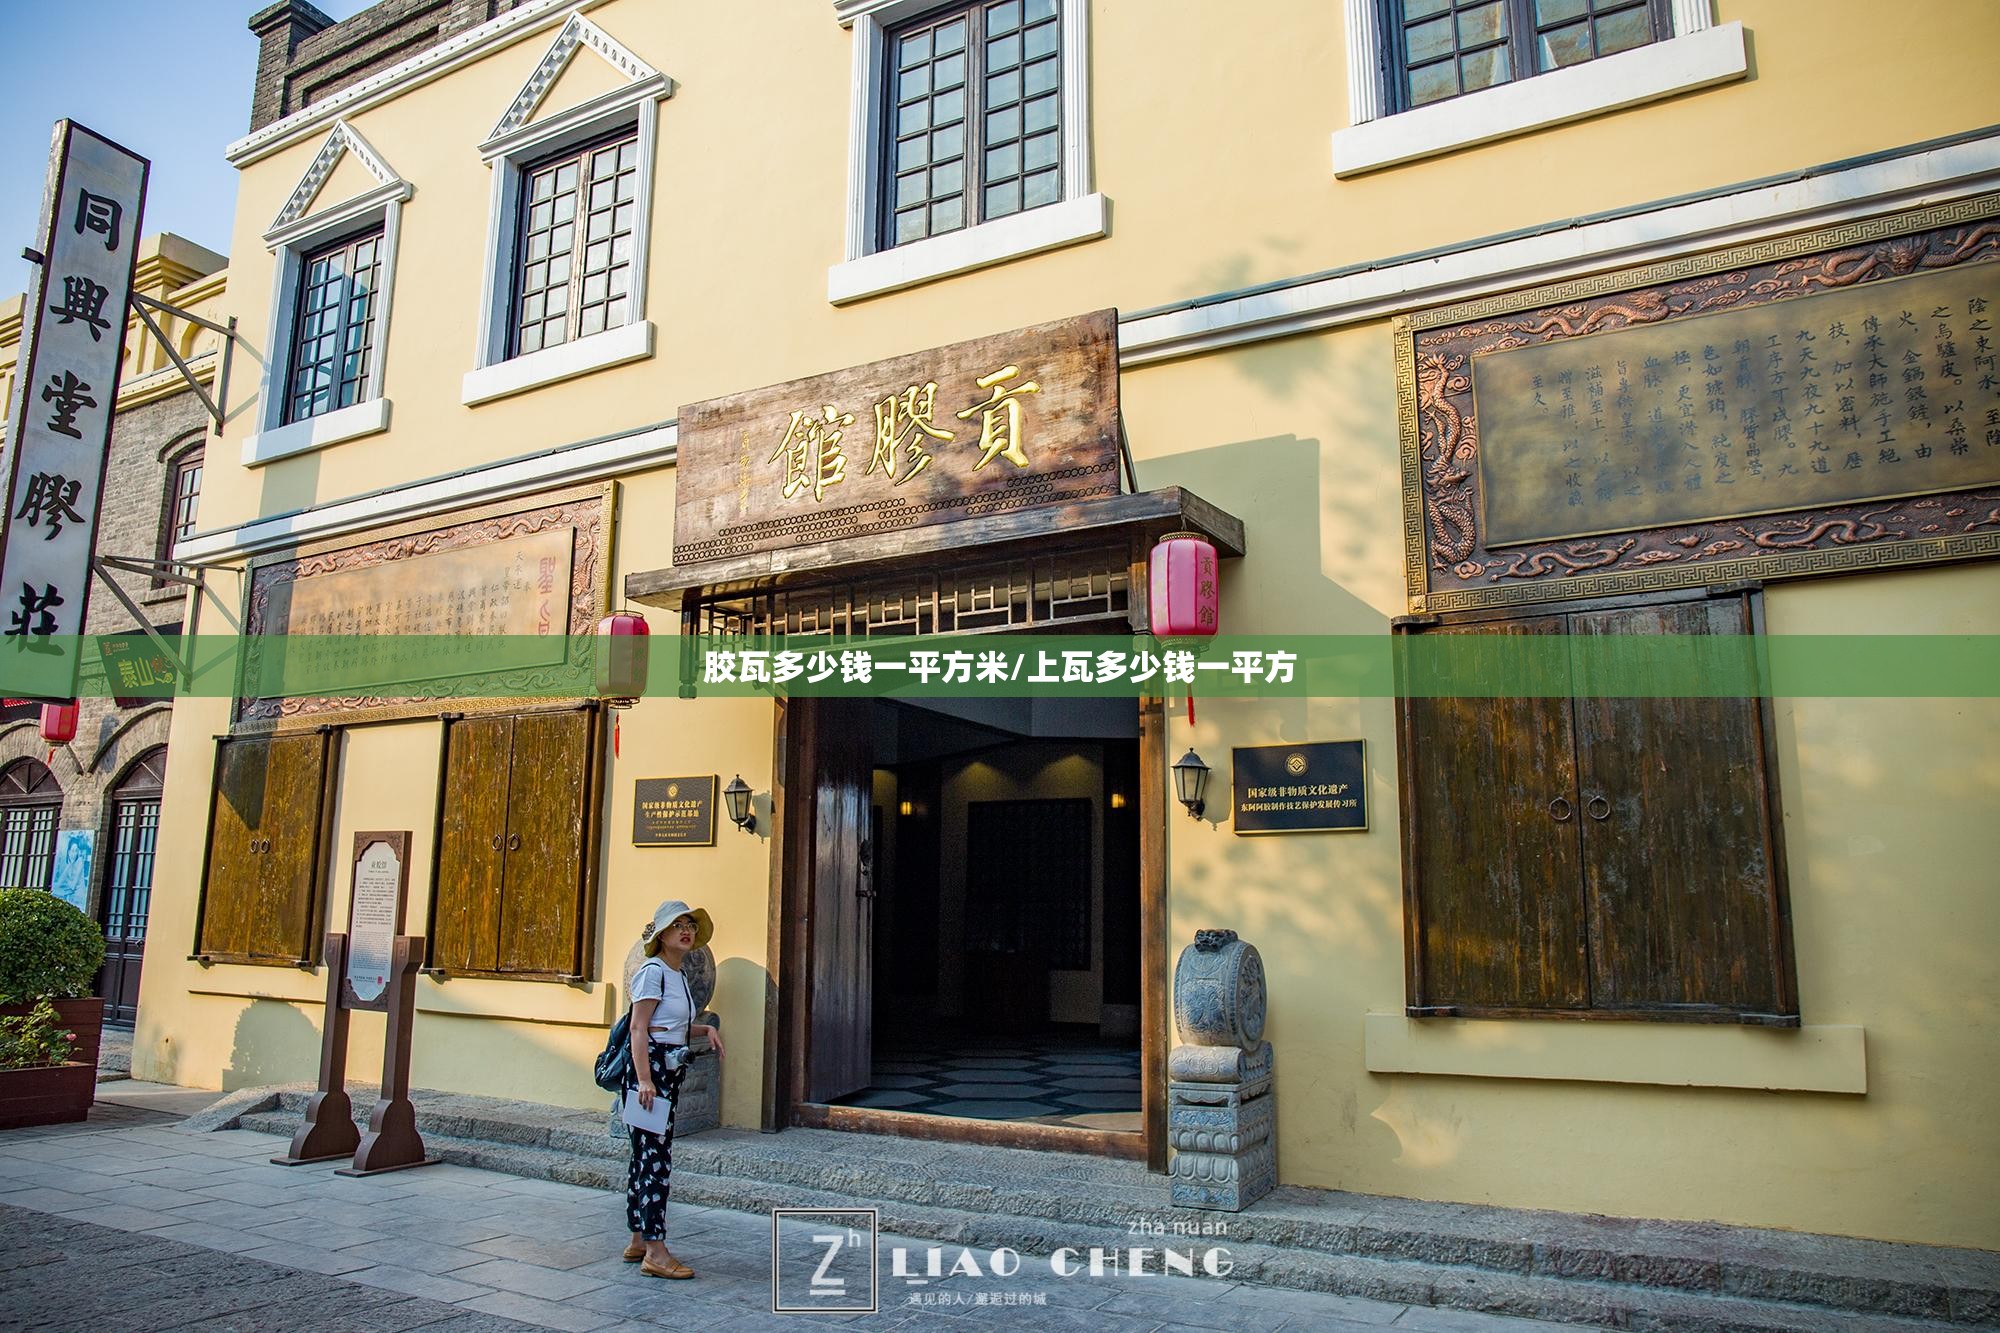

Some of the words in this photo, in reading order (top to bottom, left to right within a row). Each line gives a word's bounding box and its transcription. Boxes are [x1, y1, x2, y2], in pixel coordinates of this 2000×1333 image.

[767, 364, 1041, 503] 貢膠館
[1247, 783, 1348, 799] 国家级非物质文化遗产
